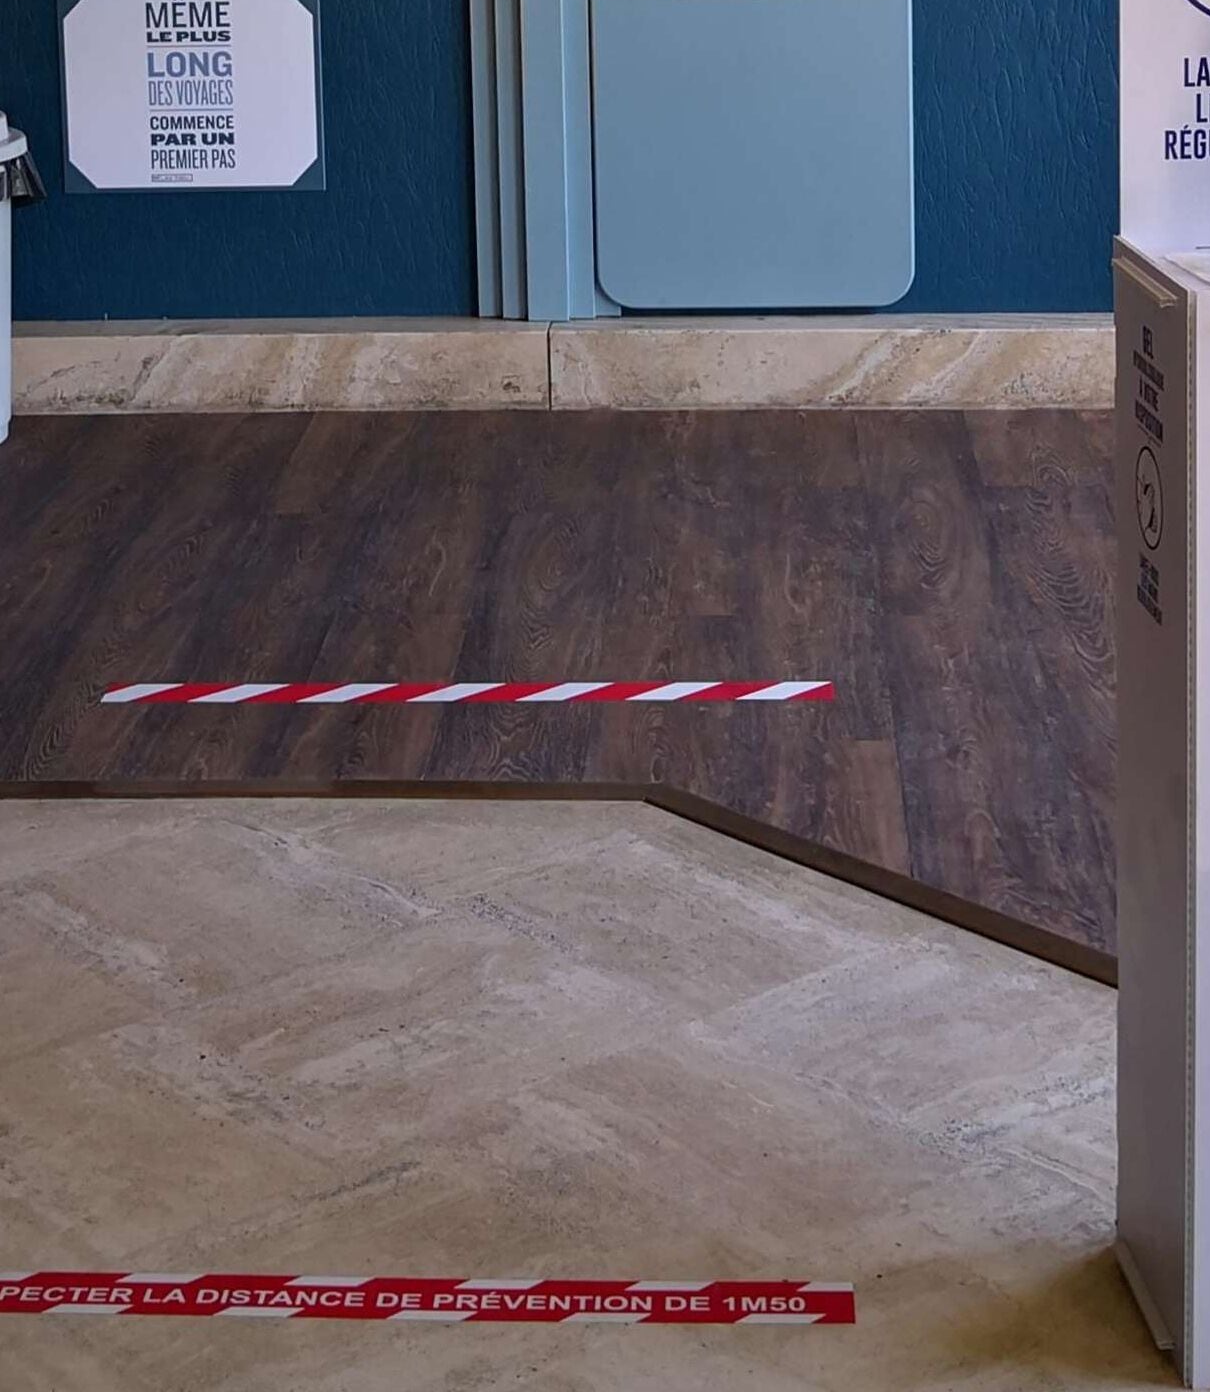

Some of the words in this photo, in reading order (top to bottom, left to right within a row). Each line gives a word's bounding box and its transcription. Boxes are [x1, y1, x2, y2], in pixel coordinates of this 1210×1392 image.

[146, 31, 172, 43] LE
[176, 30, 231, 43] PLUS
[147, 51, 233, 78] LONG
[148, 80, 173, 106] DES
[176, 79, 234, 106] VOYAGES
[149, 115, 234, 131] COMMENCE
[150, 133, 198, 146] PAR
[201, 132, 235, 146] UN
[150, 149, 208, 170] PREMIER
[211, 149, 236, 169] PAS
[143, 1288, 187, 1304] LA
[195, 1289, 366, 1307] DISTANCE
[375, 1292, 422, 1308] DE
[432, 1291, 653, 1311] PRÉVENTION
[665, 1296, 710, 1312] DE
[722, 1297, 807, 1312] 1M50
